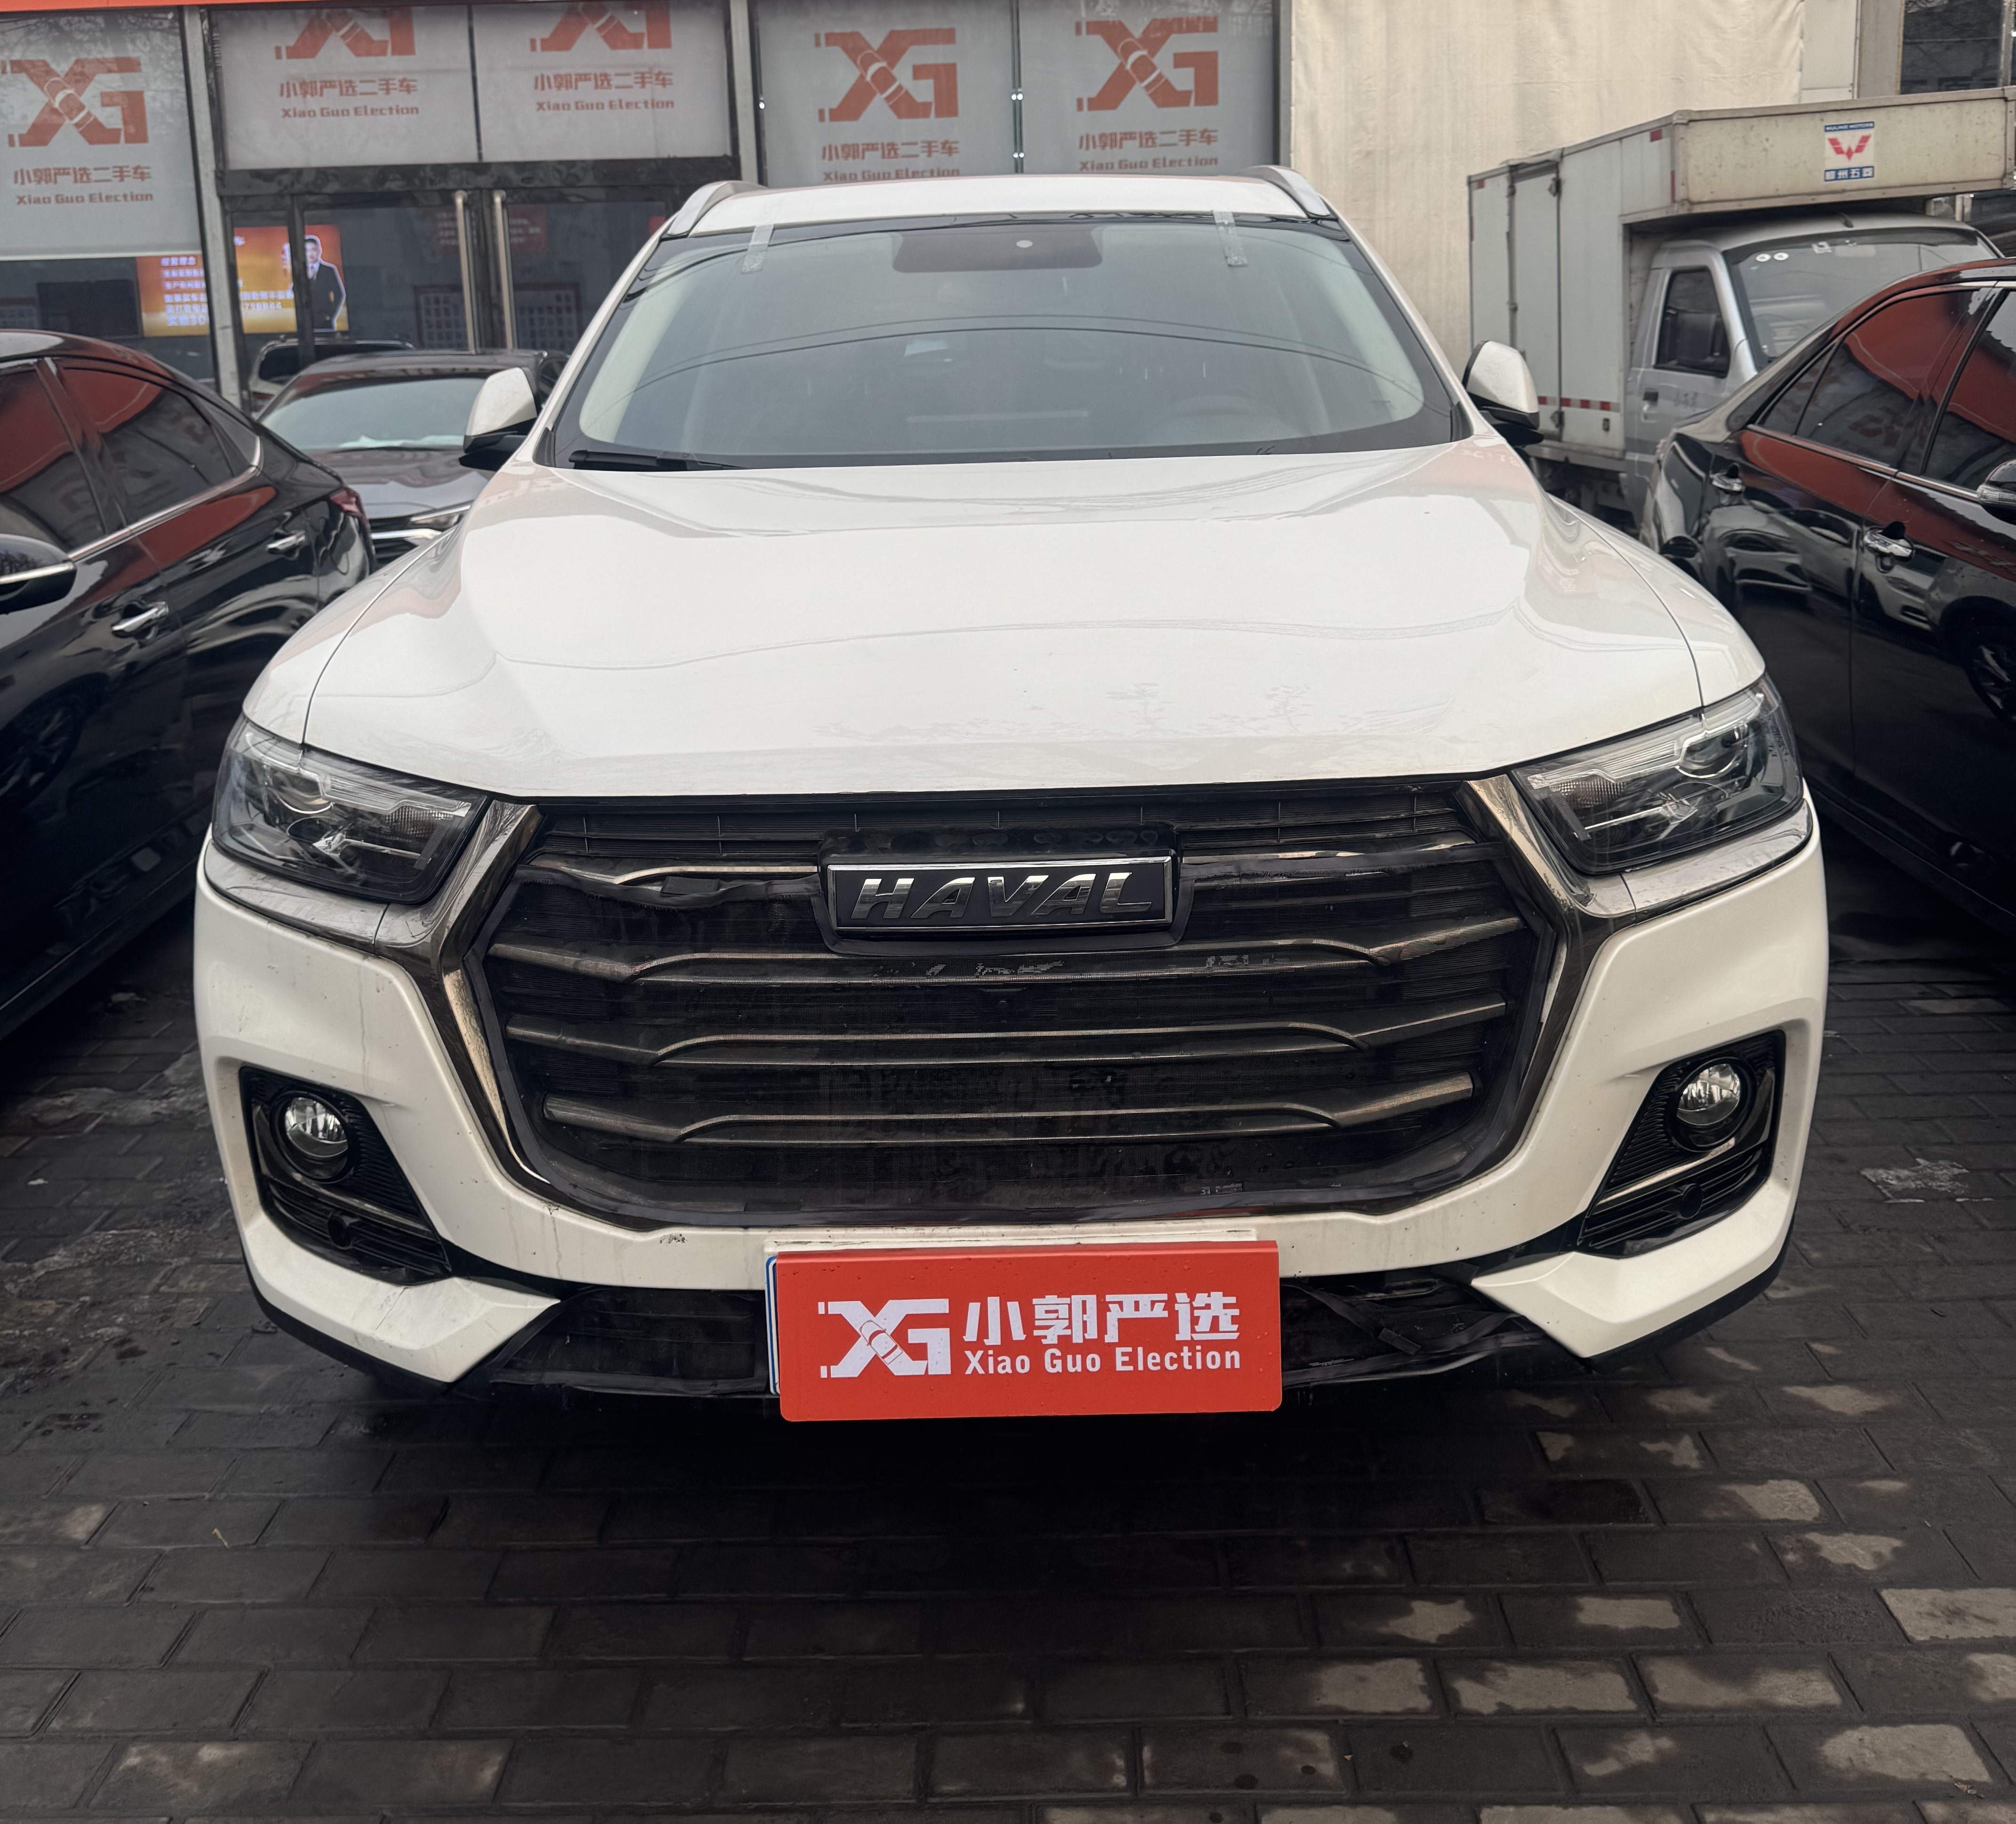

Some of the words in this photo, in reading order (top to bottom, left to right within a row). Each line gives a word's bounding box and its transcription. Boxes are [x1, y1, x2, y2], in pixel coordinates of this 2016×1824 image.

[280, 77, 418, 98] 小郭严选二手车
[534, 71, 673, 91] 小郭严选二手车
[281, 107, 317, 118] Xiao
[320, 107, 350, 117] Guo
[354, 104, 419, 116] Election
[536, 100, 571, 111] Xiao
[574, 99, 605, 111] Guo
[608, 97, 674, 110] Election
[1079, 128, 1219, 151] 小郭严选二手车
[822, 139, 960, 161] 小郭严选二手车
[1080, 160, 1114, 171] Xiao
[1118, 159, 1149, 169] Guo
[1152, 155, 1219, 168] Election
[14, 165, 151, 185] 小郭严选二手车
[824, 171, 857, 182] Xiao
[862, 169, 891, 181] Guo
[895, 166, 960, 178] Election
[17, 194, 51, 205] Xiao
[55, 193, 85, 204] Guo
[88, 191, 153, 203] Election
[850, 872, 1152, 919] HAVAL
[963, 1291, 1240, 1346] 小郭严选
[964, 1348, 1031, 1375] Xiao
[1044, 1346, 1101, 1373] Guo
[1115, 1345, 1240, 1372] Election
